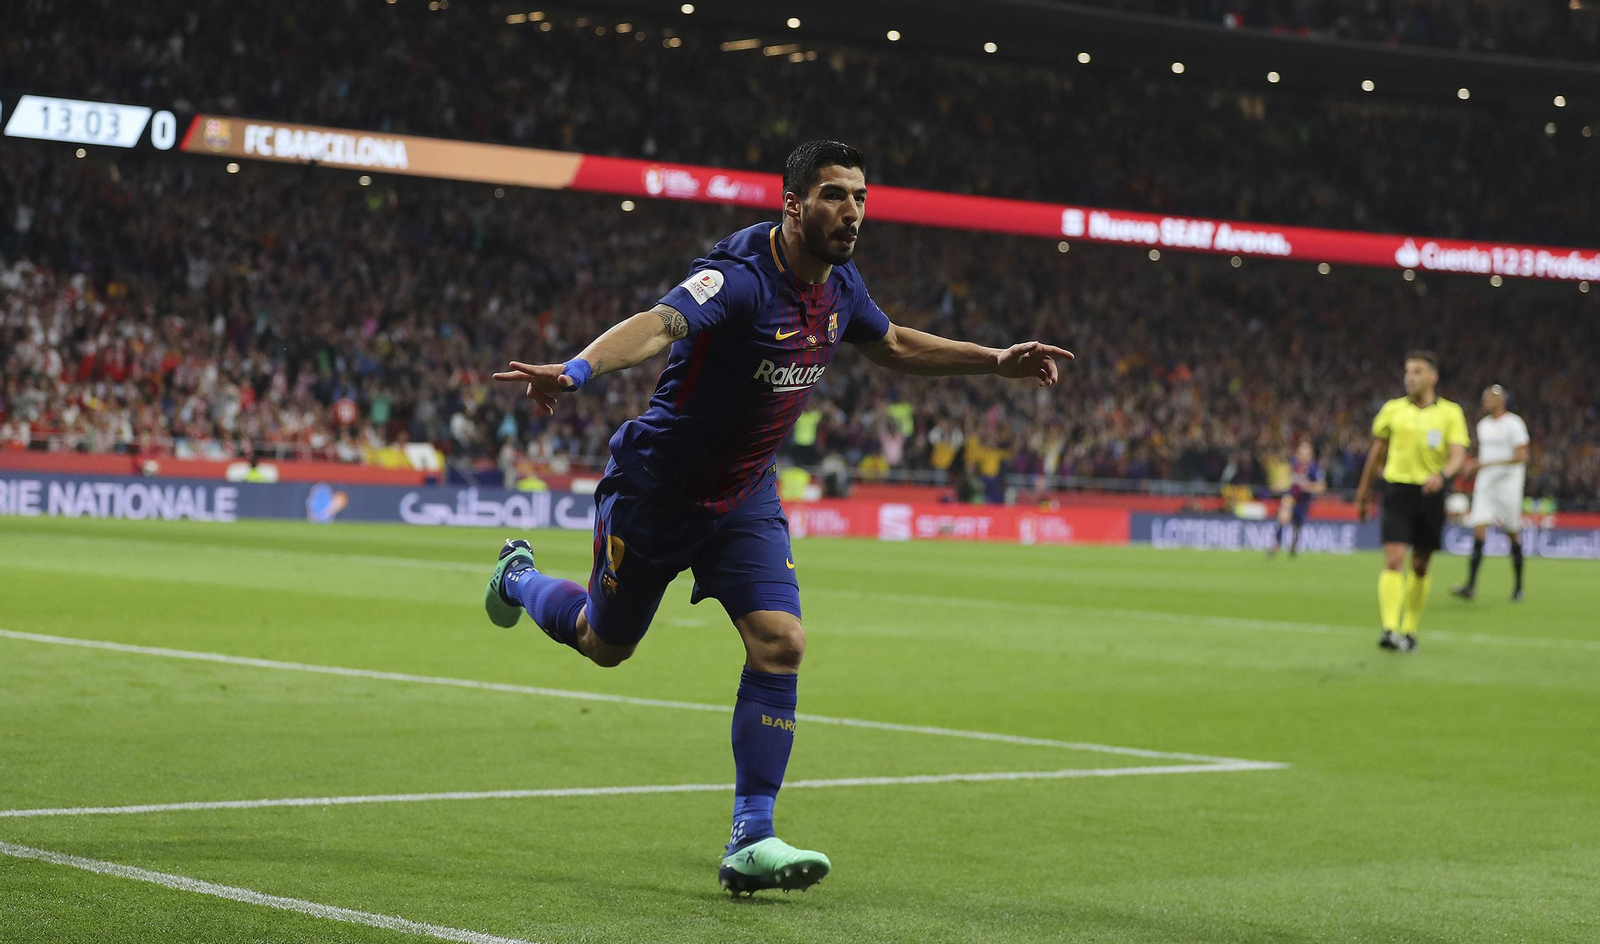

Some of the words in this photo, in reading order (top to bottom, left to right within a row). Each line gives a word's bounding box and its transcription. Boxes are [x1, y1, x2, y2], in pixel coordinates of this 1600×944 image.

[151, 110, 176, 150] 0
[244, 124, 274, 156] FC
[274, 128, 408, 170] BARCELONA
[1160, 217, 1214, 249] SEAT
[1421, 242, 1491, 274] Cuenta
[753, 359, 826, 385] Rakute
[48, 481, 238, 522] NATIONALE
[1151, 517, 1243, 550] LOTERIE
[1244, 520, 1357, 554] NAINALE
